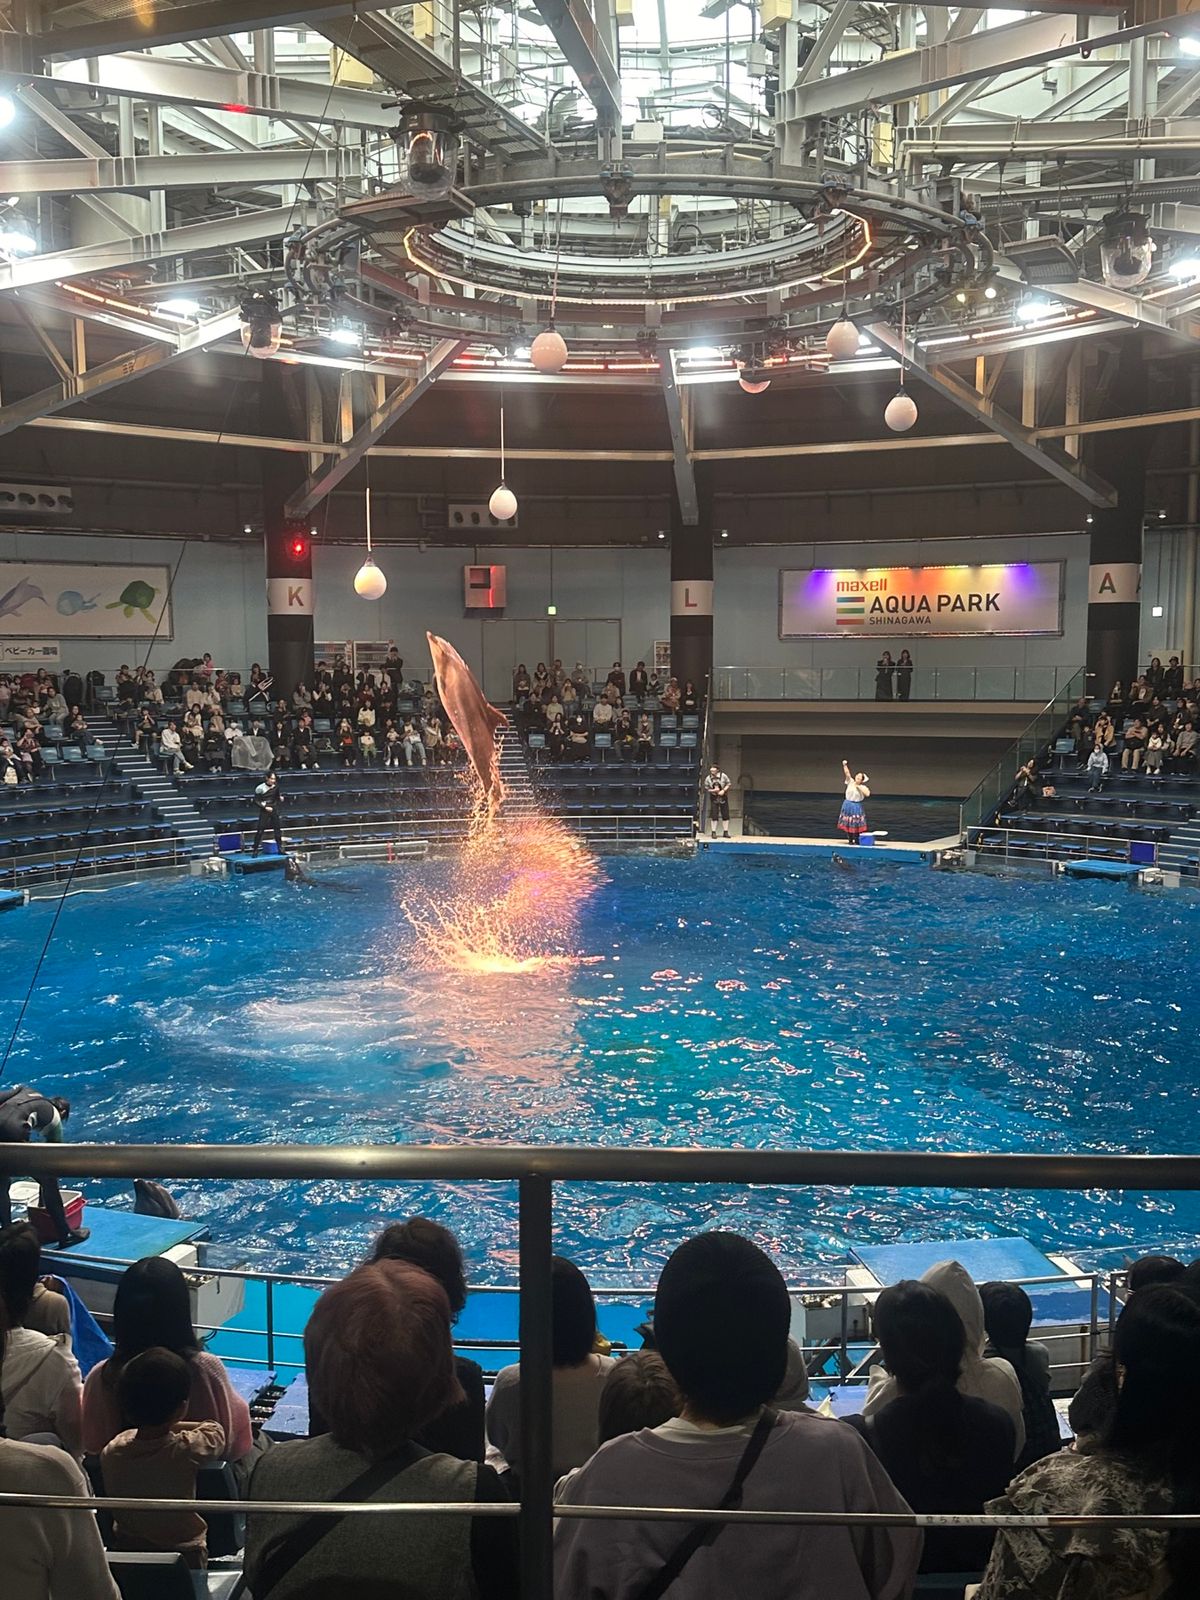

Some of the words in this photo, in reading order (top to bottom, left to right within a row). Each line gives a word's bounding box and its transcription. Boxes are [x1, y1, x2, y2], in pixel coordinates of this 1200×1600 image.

[836, 578, 888, 592] maxell
[1098, 572, 1117, 594] A
[287, 586, 305, 607] K
[684, 587, 698, 608] L
[869, 595, 932, 614] AQUA
[936, 592, 1001, 613] PARK
[869, 616, 932, 625] SHINAGAWA
